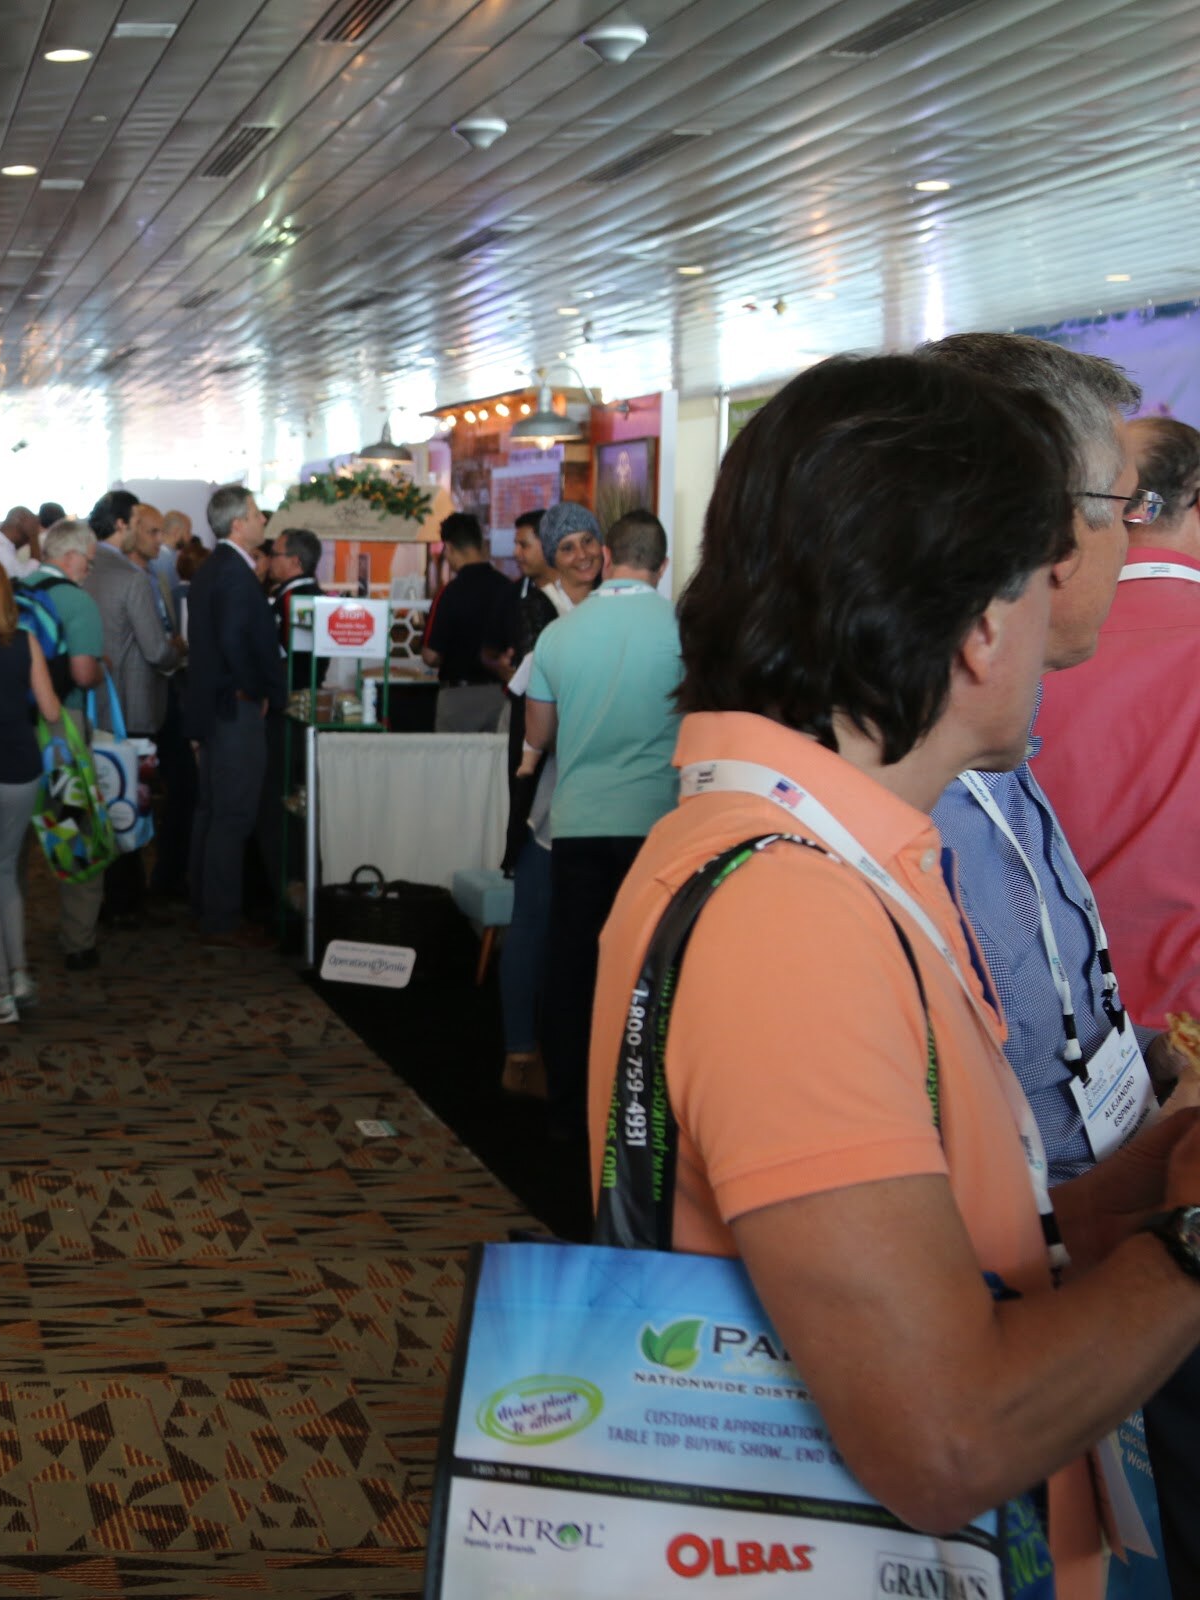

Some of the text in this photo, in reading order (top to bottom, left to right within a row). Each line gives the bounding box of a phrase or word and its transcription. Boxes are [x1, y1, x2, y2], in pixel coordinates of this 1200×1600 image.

[624, 988, 650, 1147] 1-800-759-4931
[1104, 1075, 1135, 1120] ALEJANDRO
[1114, 1098, 1136, 1128] ESPINAL
[713, 1326, 792, 1361] PA
[635, 1372, 814, 1401] NATIONWIDE DISTR
[530, 1407, 572, 1429] attend
[644, 1408, 824, 1442] CUSTOMER APPRECIATION
[608, 1425, 647, 1445] TABLE
[654, 1431, 680, 1448] TOP
[685, 1435, 736, 1455] BUYING
[796, 1446, 825, 1464] END
[468, 1508, 603, 1551] NATROL
[667, 1533, 812, 1577] OLBAS
